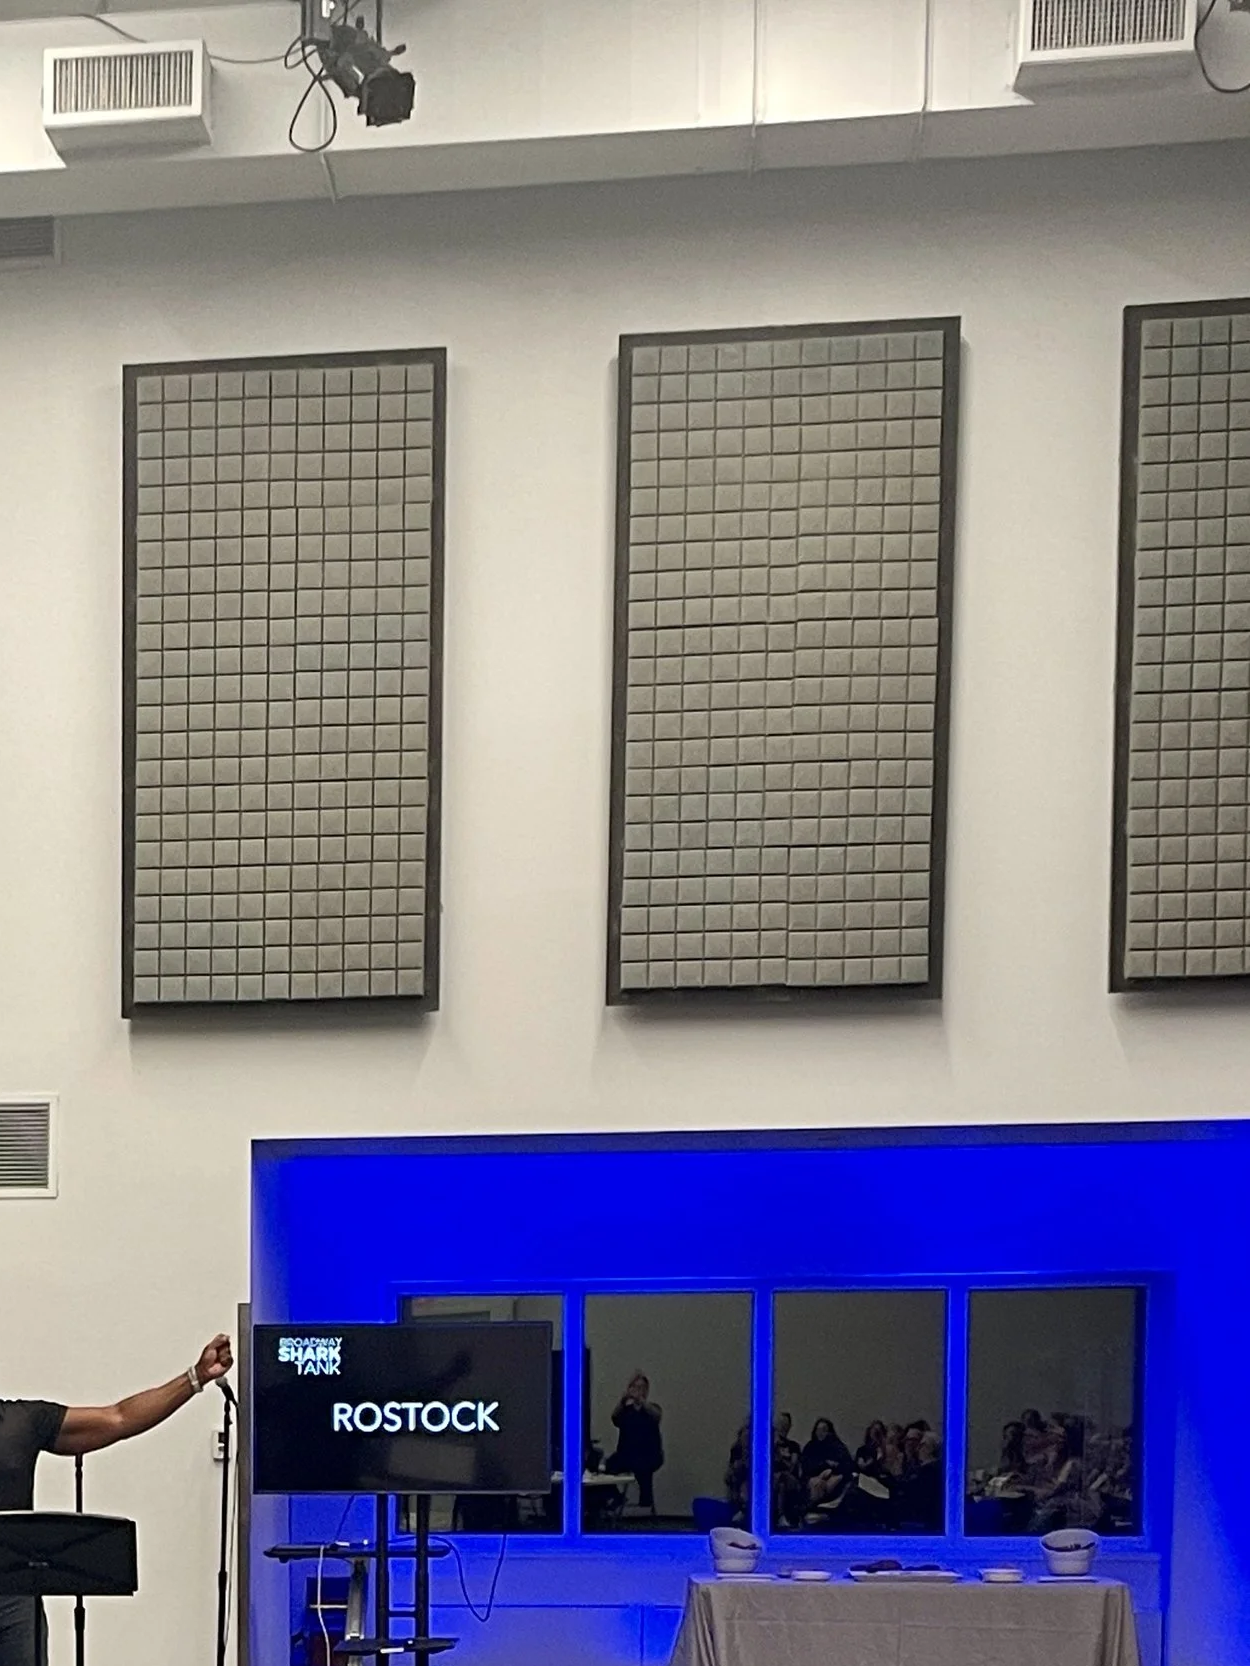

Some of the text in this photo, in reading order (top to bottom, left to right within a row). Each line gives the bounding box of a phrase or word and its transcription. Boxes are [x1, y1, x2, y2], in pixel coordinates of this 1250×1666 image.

[279, 1337, 342, 1347] BROADWAY
[278, 1347, 341, 1361] SHARK
[294, 1360, 341, 1375] TANK
[333, 1401, 499, 1432] ROSTOCK
